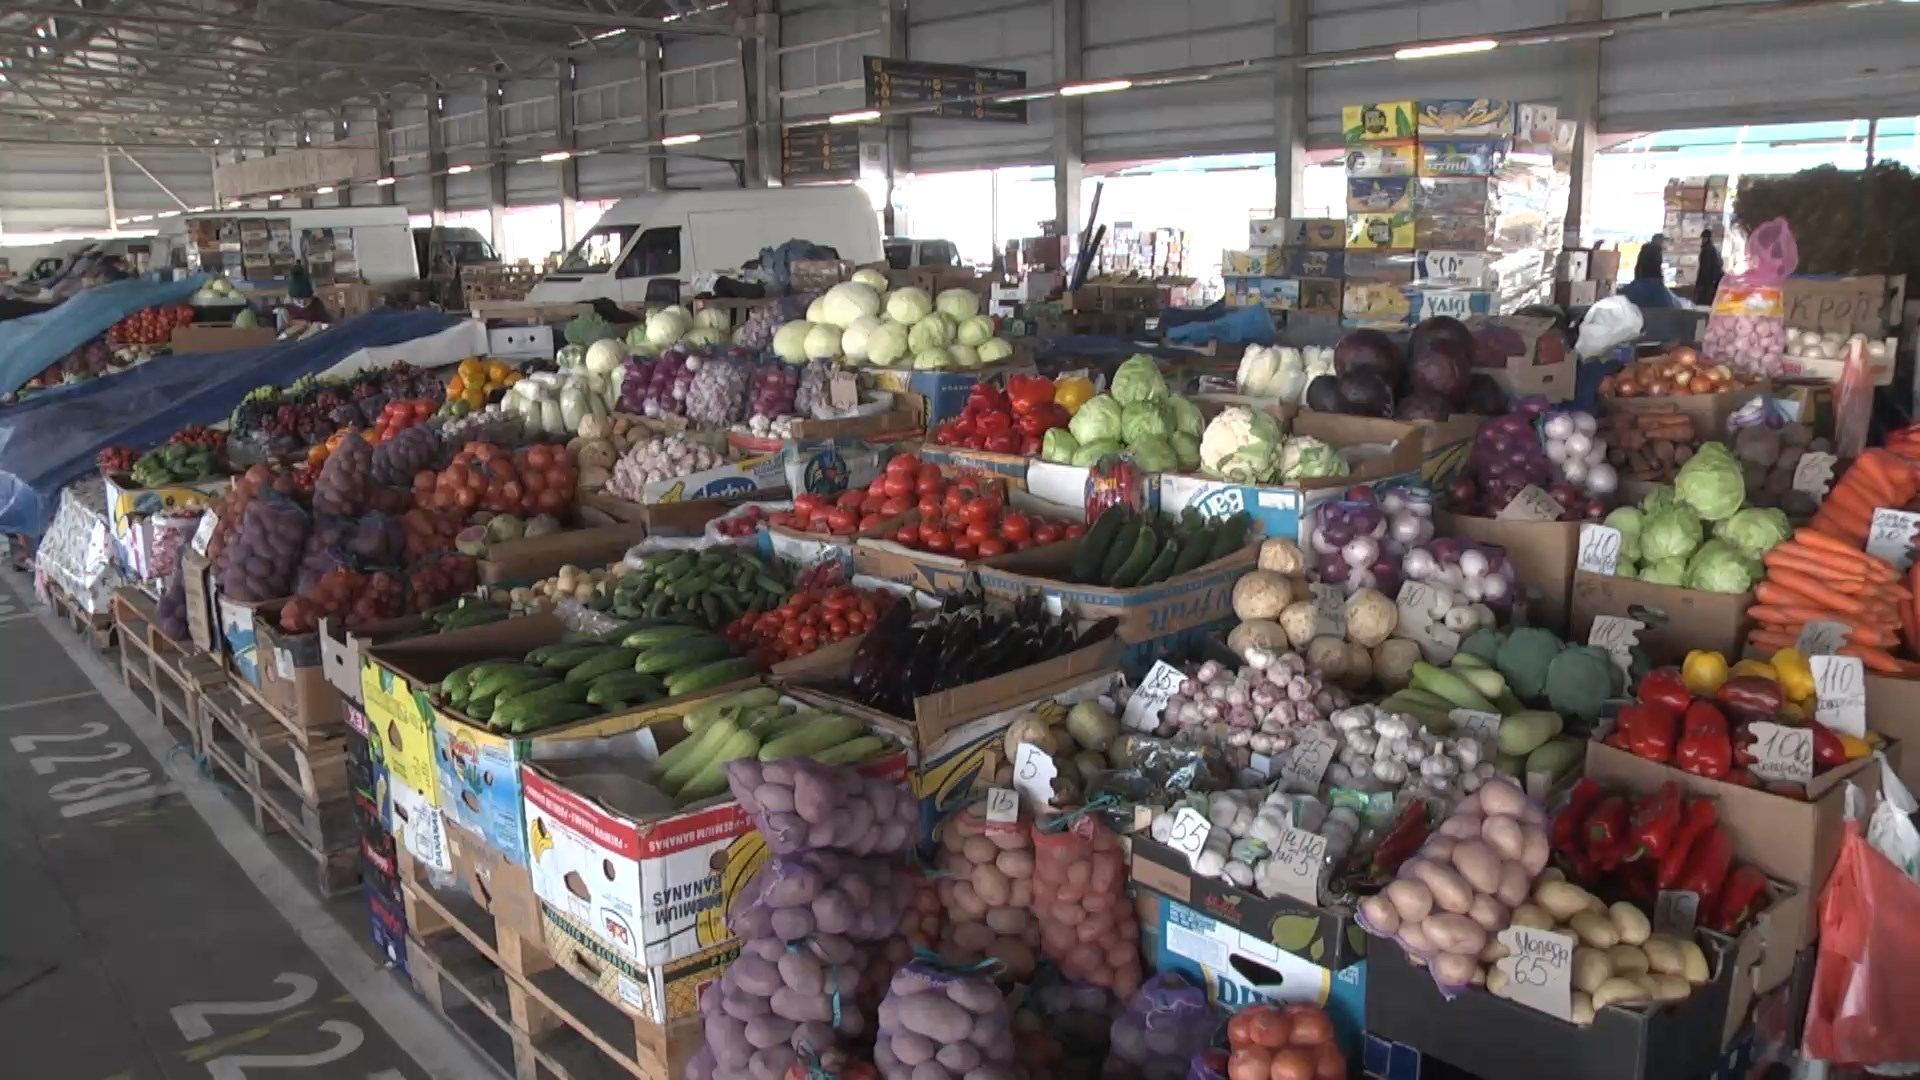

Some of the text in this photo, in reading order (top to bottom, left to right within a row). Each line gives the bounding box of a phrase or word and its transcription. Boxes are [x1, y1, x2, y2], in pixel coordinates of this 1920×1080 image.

[1820, 657, 1855, 695] 110
[1170, 814, 1208, 851] 55
[652, 874, 722, 906] BANANAS
[1514, 955, 1547, 987] 65
